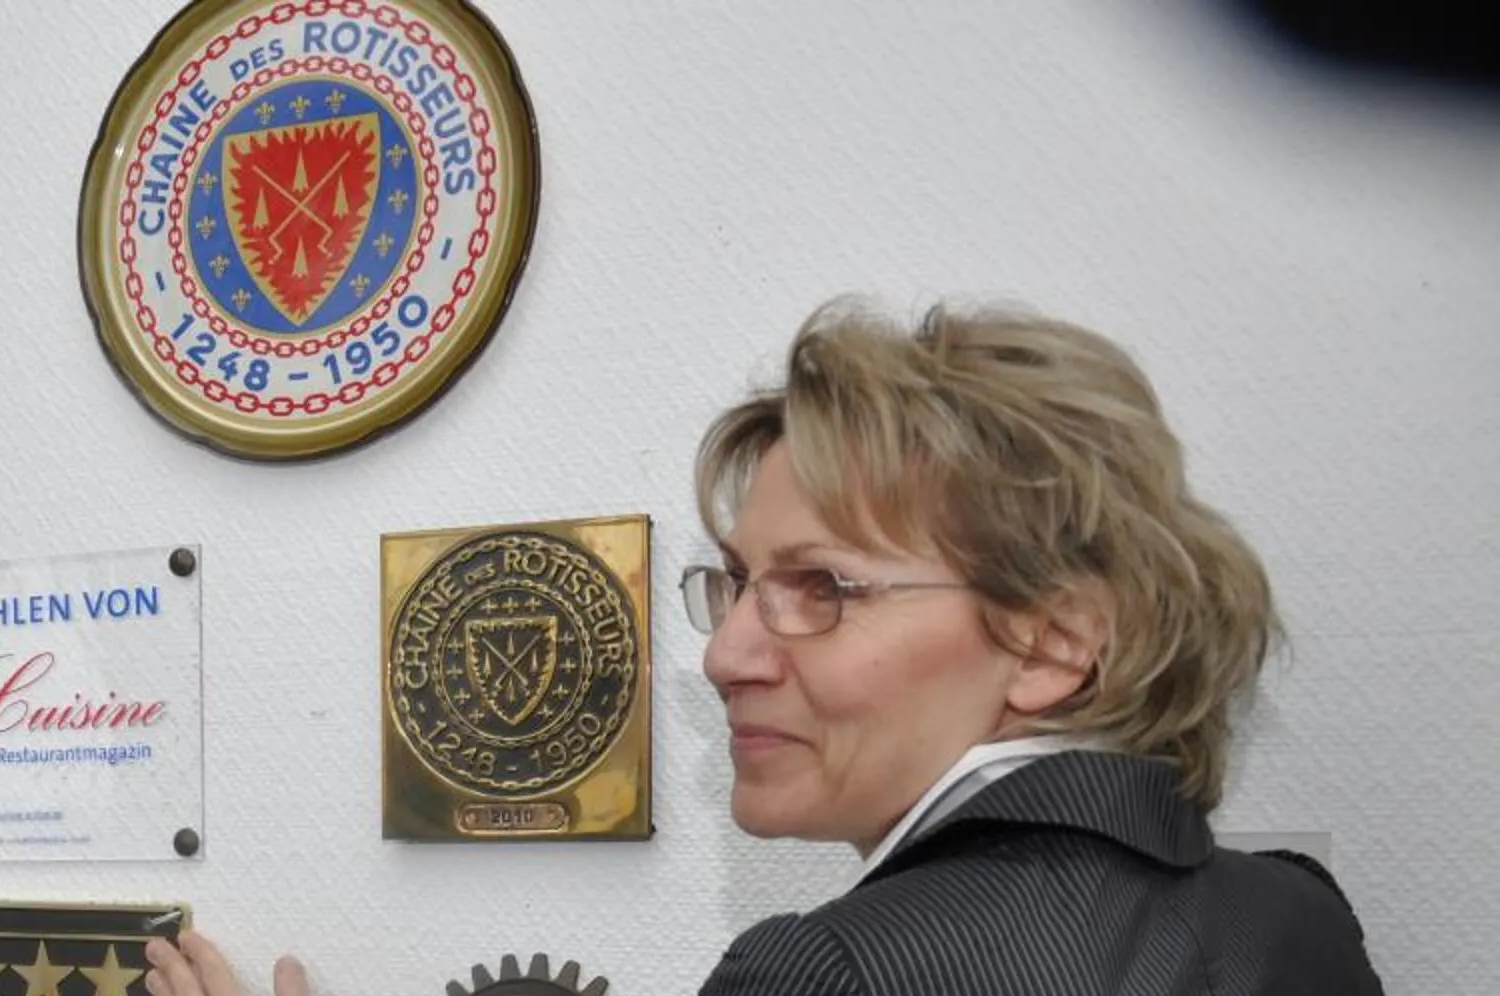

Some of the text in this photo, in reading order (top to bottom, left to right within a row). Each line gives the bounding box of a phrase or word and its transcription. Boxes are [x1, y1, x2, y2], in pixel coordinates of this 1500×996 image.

[138, 21, 476, 236] CHAINE DES ROTISSEURS
[170, 313, 271, 392] 1248
[322, 295, 429, 385] 1950
[82, 586, 160, 619] VON
[405, 578, 462, 689] CHAINE
[503, 550, 623, 678] ROTISSEURS
[427, 720, 497, 776] 1248
[530, 713, 601, 770] 1950
[490, 806, 533, 824] 2010
